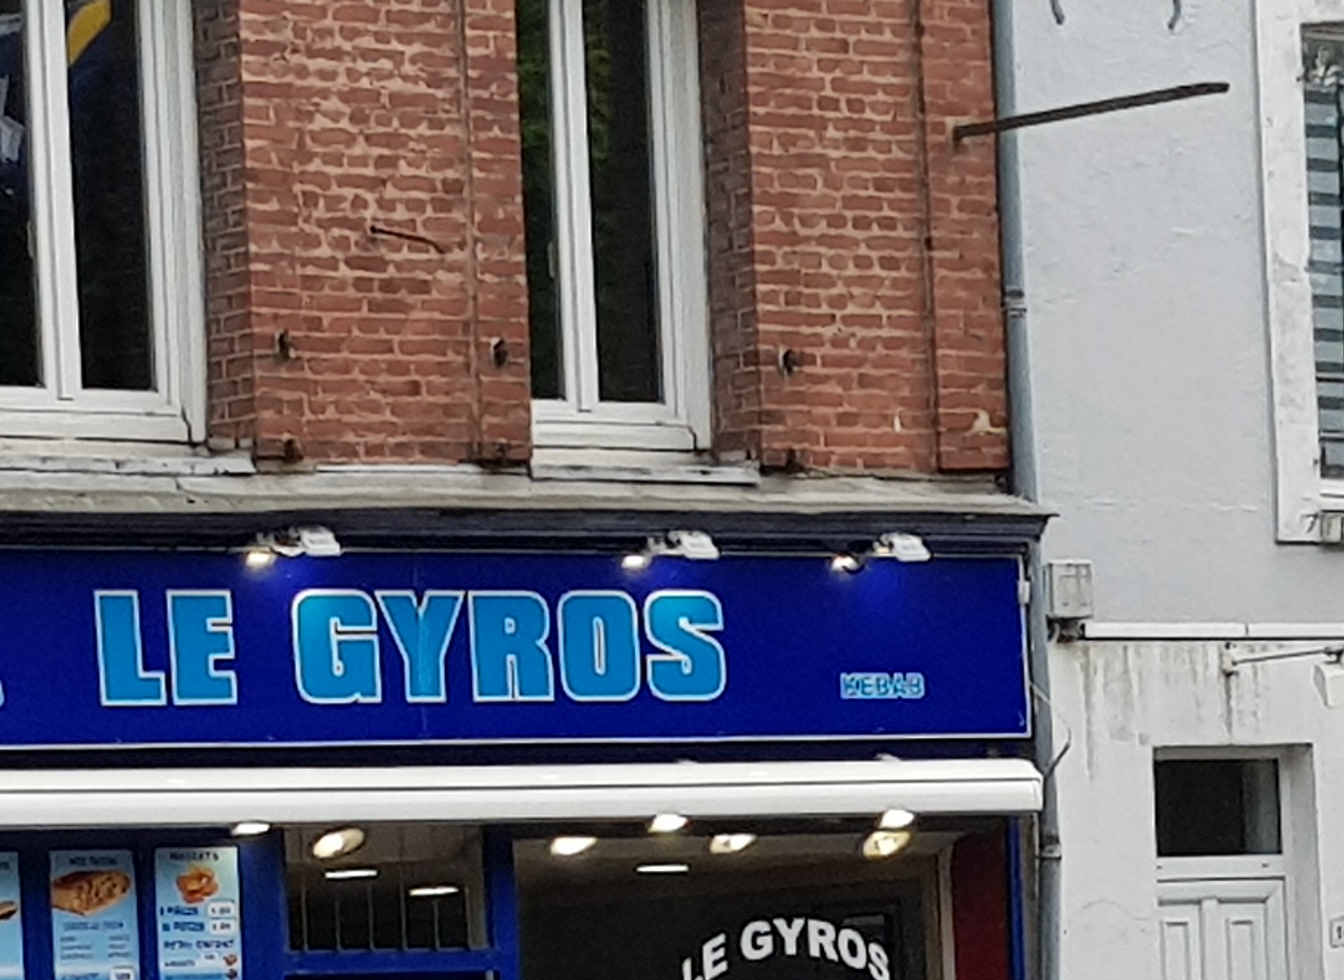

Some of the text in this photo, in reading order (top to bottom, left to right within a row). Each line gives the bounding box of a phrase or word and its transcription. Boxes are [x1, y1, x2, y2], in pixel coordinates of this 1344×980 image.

[93, 588, 727, 707] LE GYROS
[840, 672, 926, 699] KEBAB
